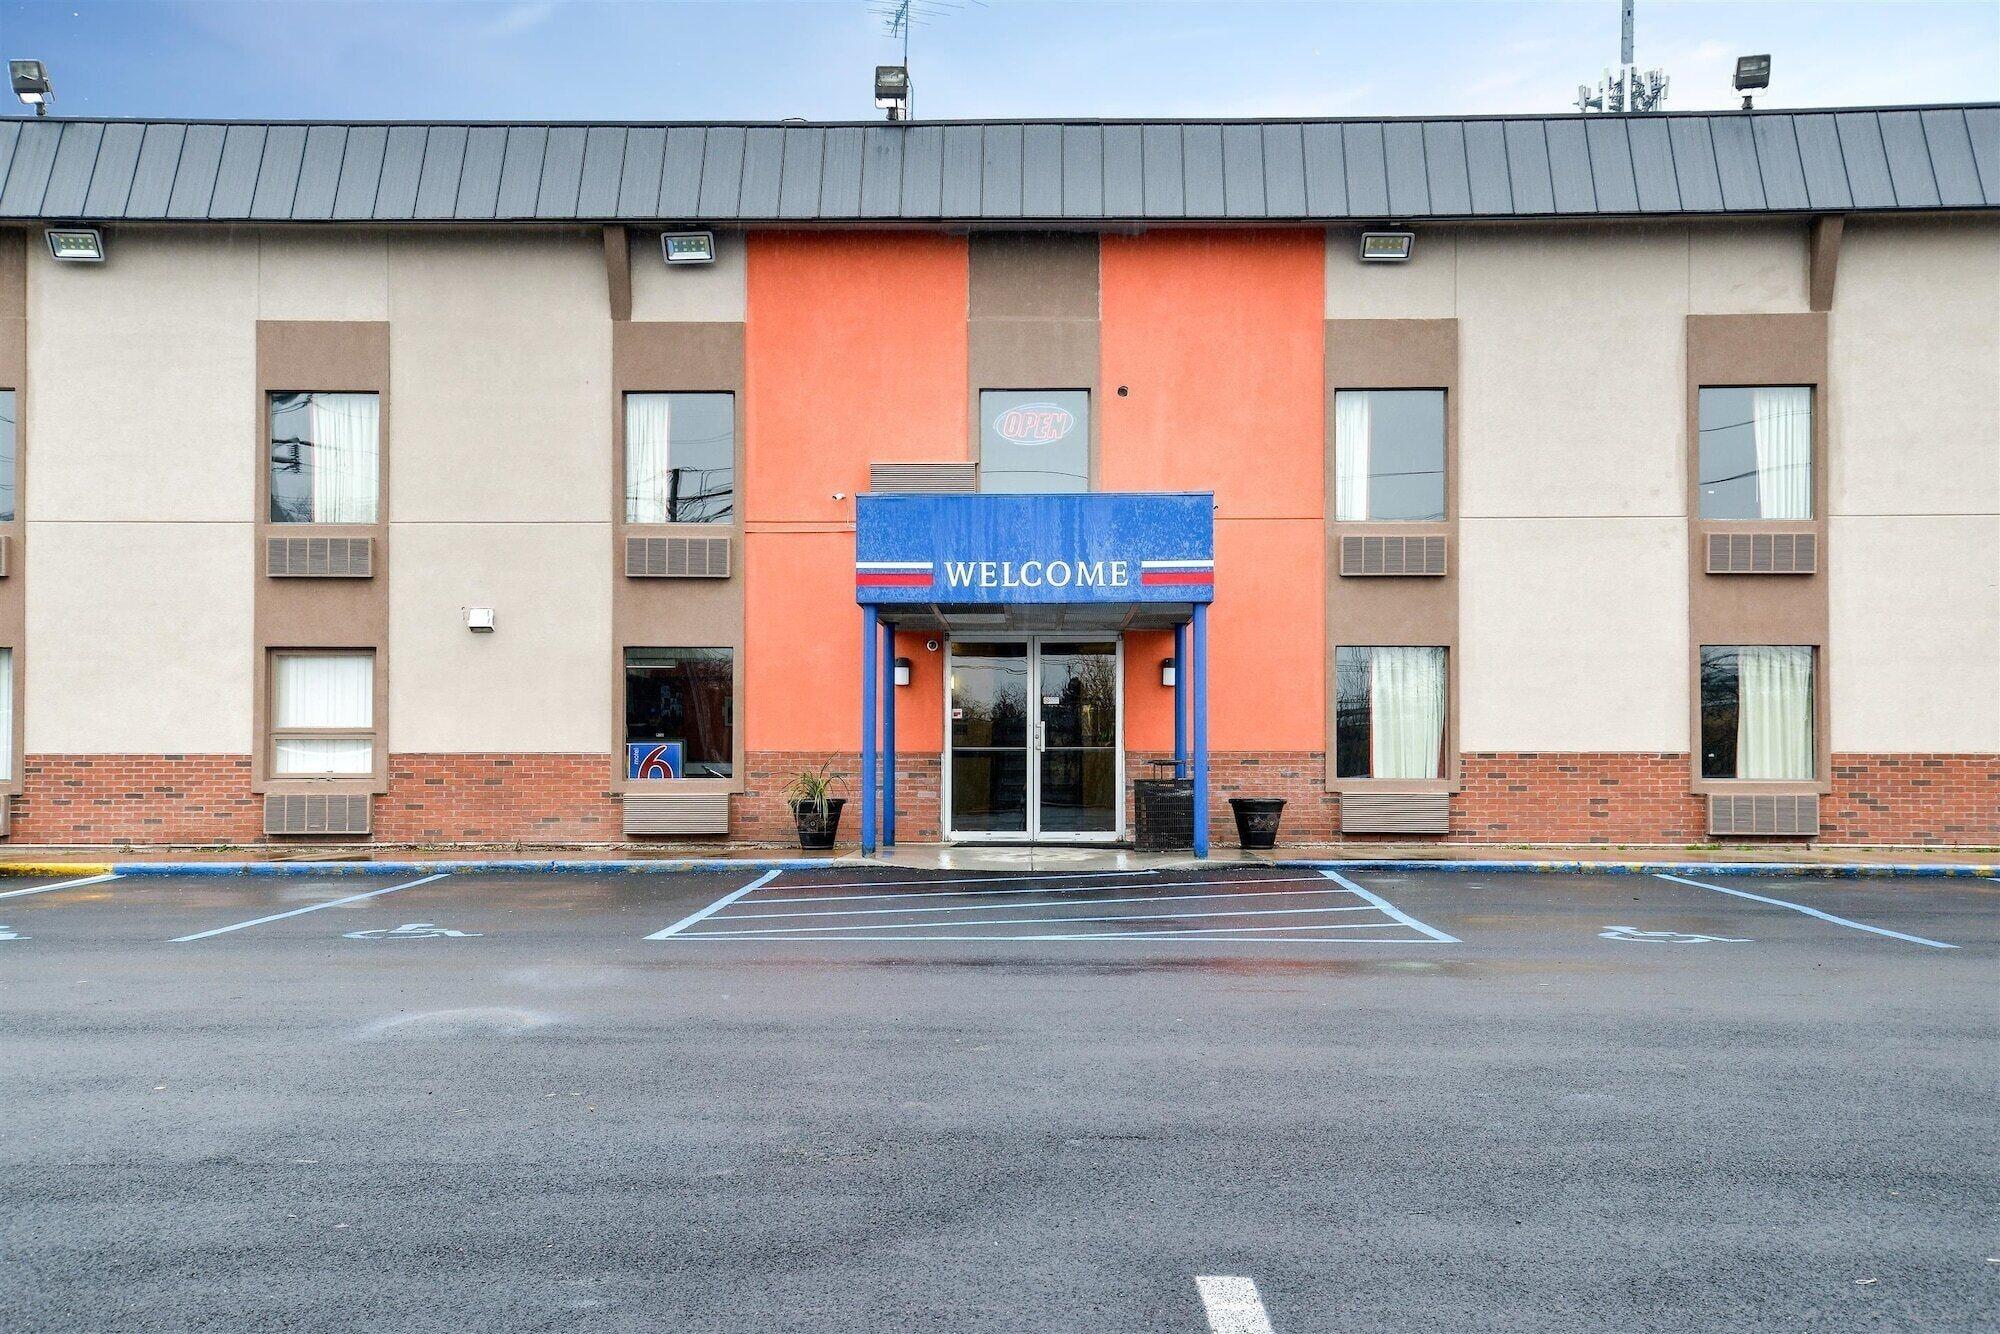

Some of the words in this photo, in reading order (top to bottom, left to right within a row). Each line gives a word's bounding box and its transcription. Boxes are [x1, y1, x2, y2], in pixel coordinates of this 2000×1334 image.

[1003, 411, 1068, 440] OPEN
[944, 560, 1129, 588] WELCOME
[638, 744, 674, 779] 6
